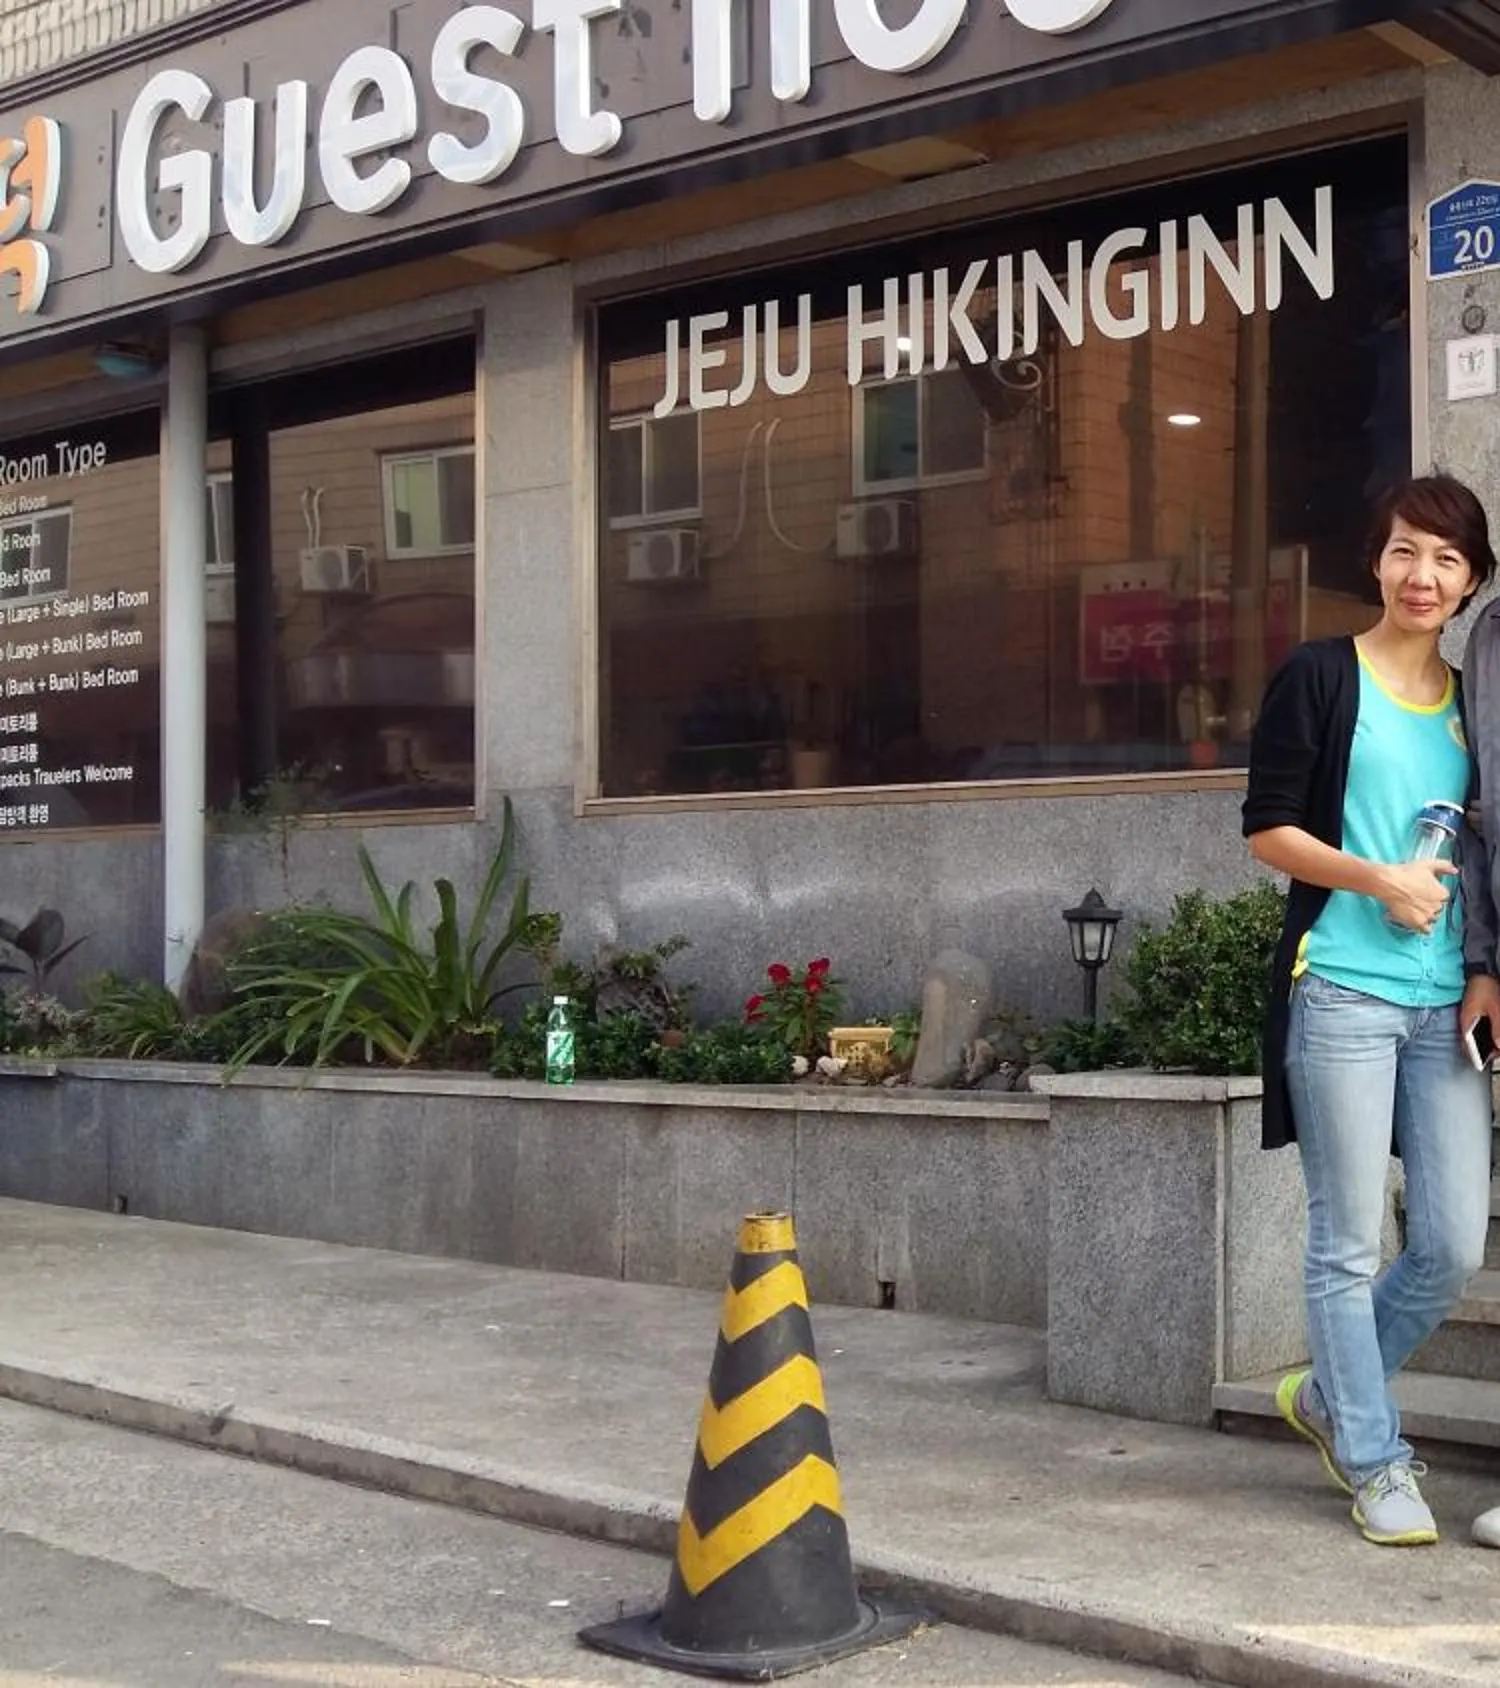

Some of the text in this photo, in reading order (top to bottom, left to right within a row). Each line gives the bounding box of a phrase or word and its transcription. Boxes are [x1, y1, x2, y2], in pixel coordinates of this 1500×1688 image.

[117, 0, 622, 273] Guest
[1454, 225, 1494, 264] 20
[653, 185, 1333, 419] JEJU HIKINGINN
[56, 441, 107, 478] Type
[19, 496, 48, 514] Room
[11, 533, 41, 551] Room
[0, 567, 51, 588] Bed Room
[93, 594, 115, 612] Bed
[117, 590, 149, 608] Room
[85, 631, 109, 651] Bed
[111, 629, 143, 647] Room
[82, 669, 105, 688] Bed
[107, 668, 139, 685] Room
[33, 766, 81, 786] Travelers
[84, 763, 133, 782] Welcome
